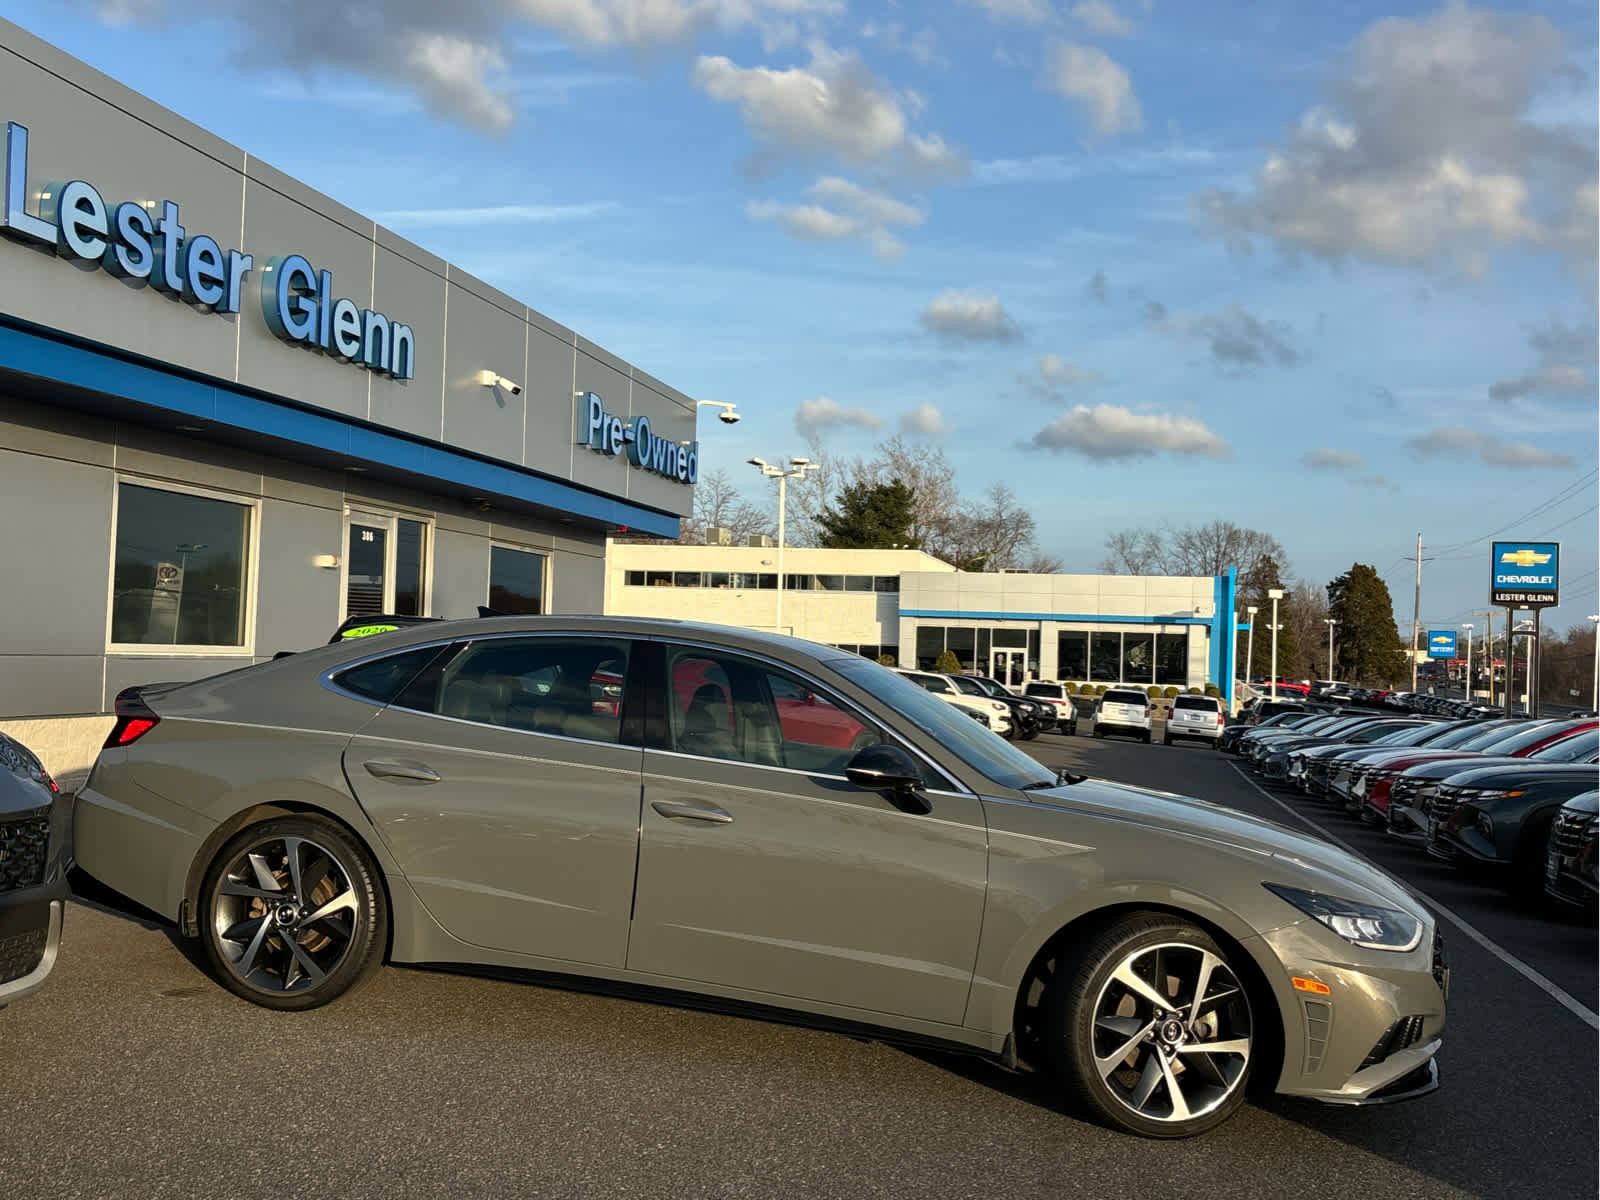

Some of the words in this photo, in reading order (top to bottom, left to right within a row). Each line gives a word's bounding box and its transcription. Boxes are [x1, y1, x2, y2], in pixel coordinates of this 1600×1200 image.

[5, 121, 253, 313] Lester
[273, 254, 415, 379] Glenn
[584, 391, 699, 484] Pre-Owned
[1495, 593, 1526, 601] LESTER
[1527, 594, 1554, 602] GLENN
[1496, 575, 1554, 584] CHEVROLET
